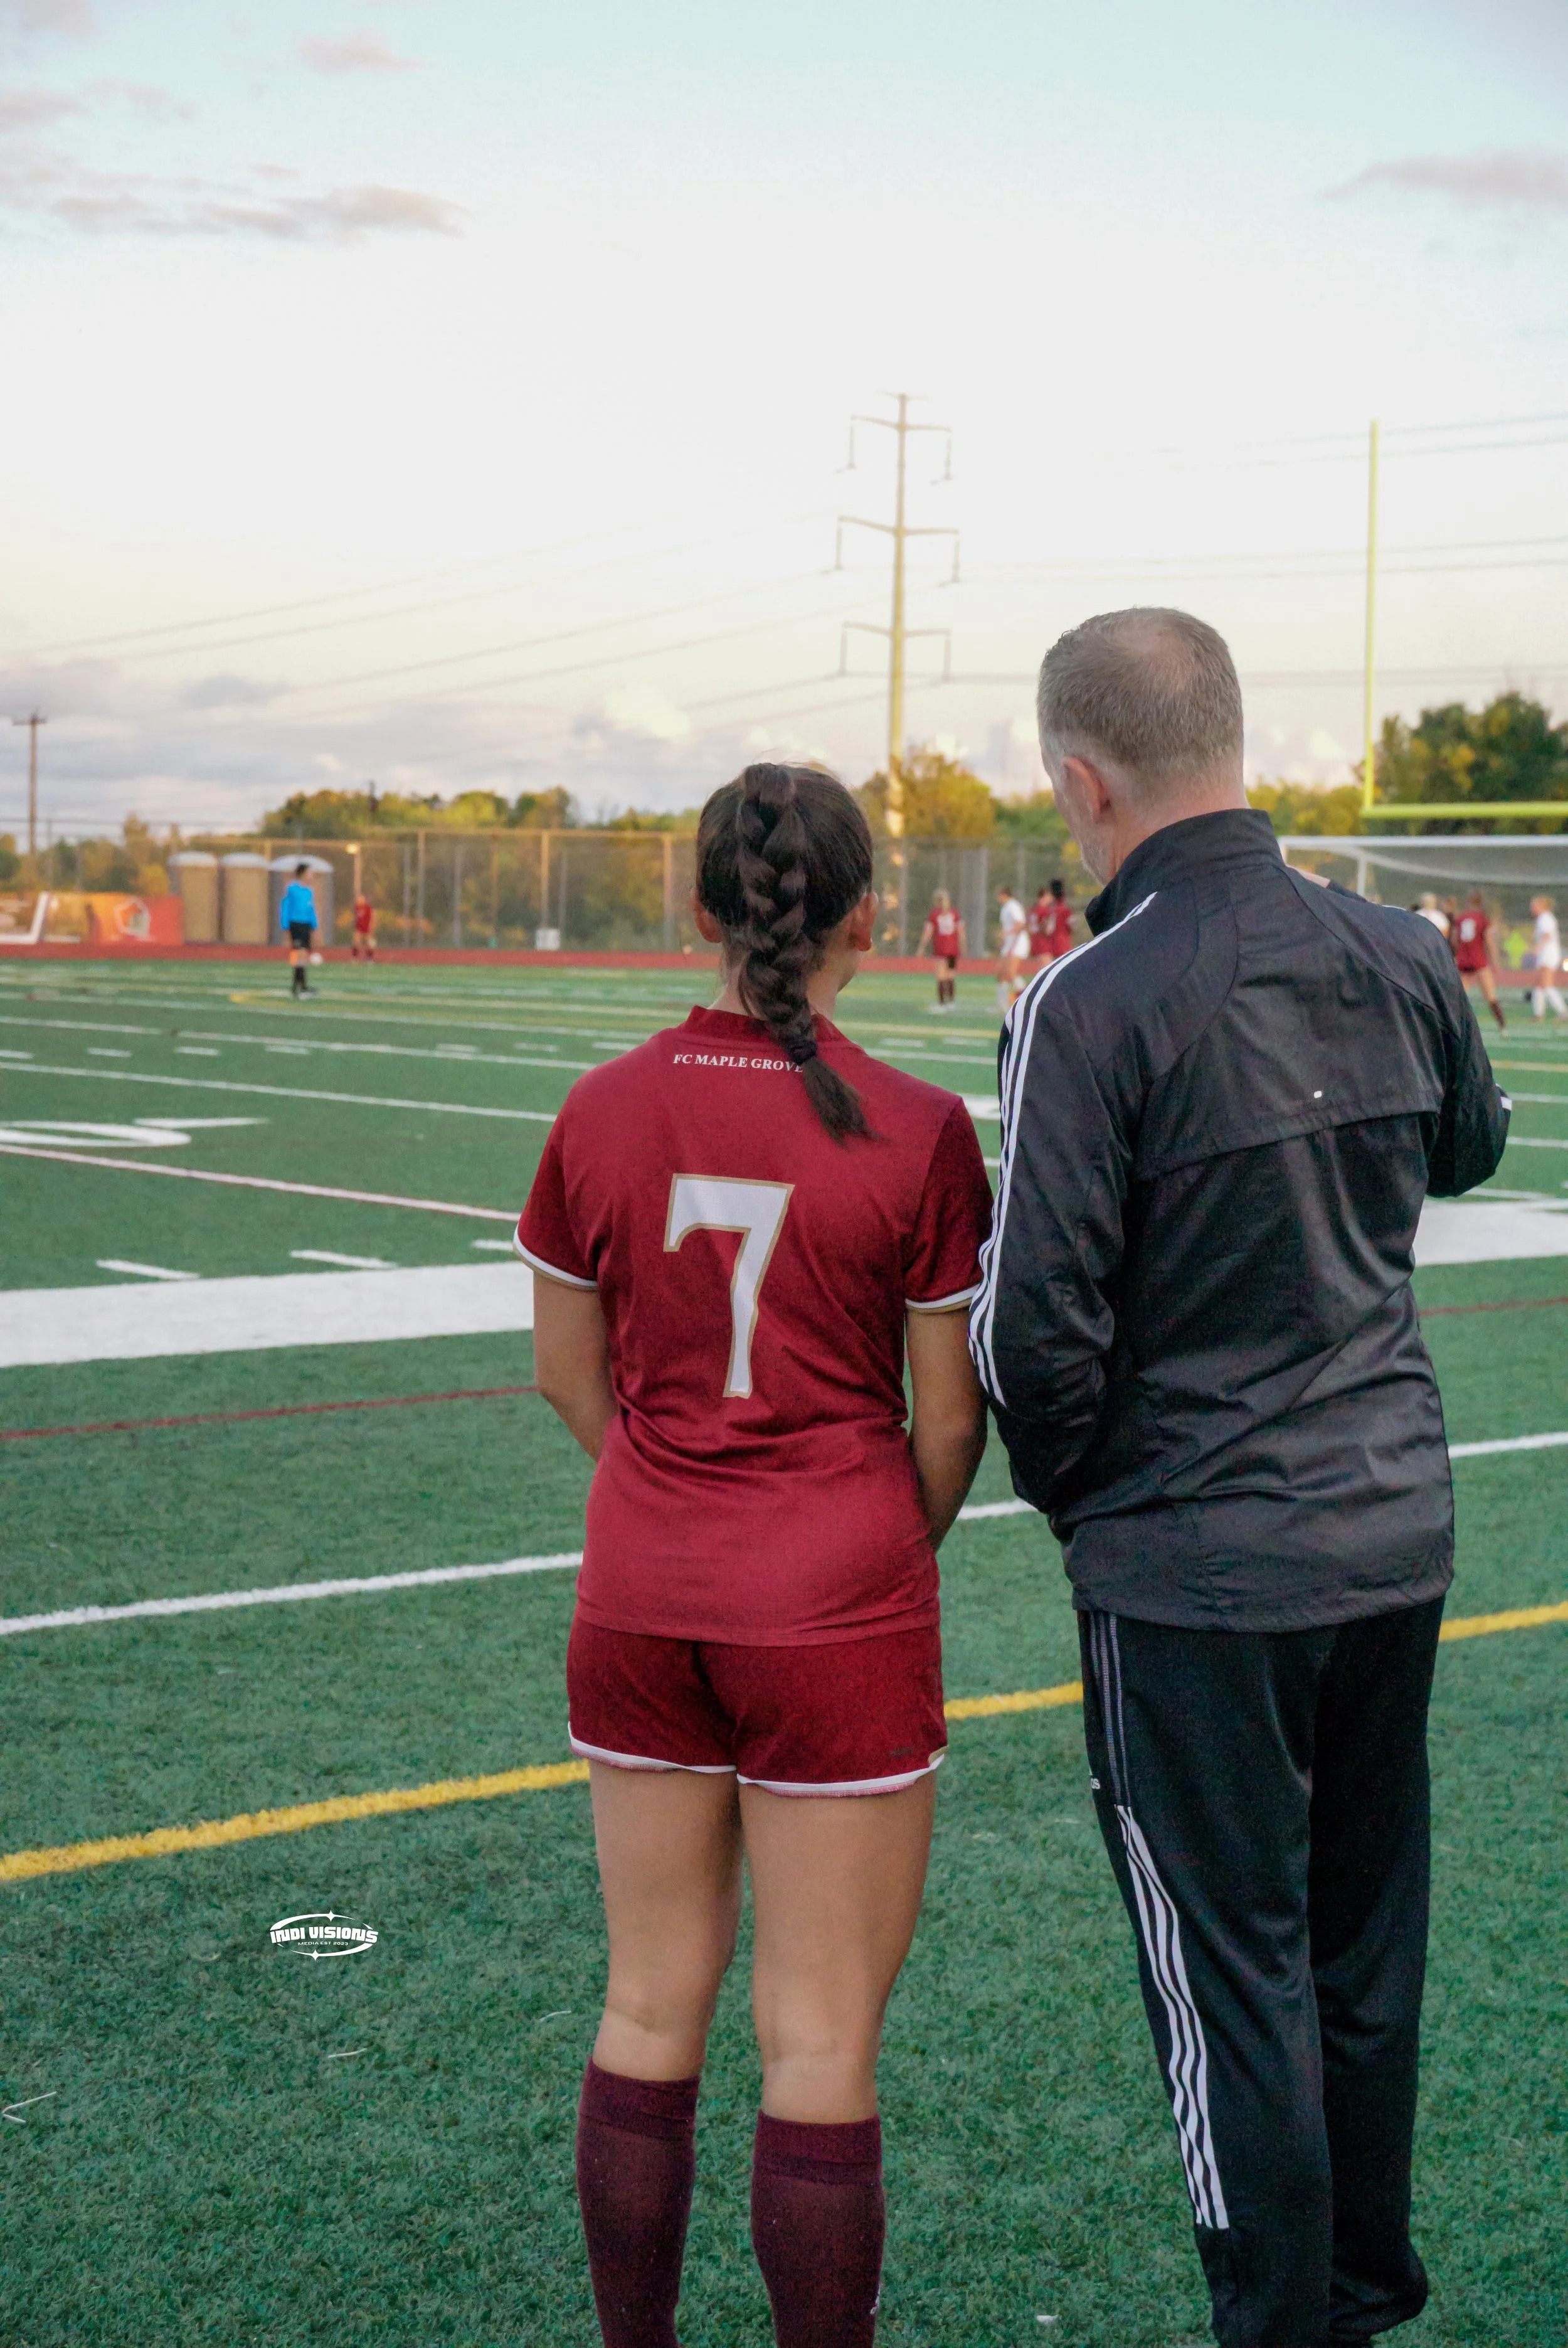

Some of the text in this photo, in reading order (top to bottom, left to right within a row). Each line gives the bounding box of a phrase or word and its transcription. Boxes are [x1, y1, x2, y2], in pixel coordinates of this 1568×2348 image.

[672, 1054, 693, 1064] FC
[695, 1054, 748, 1067] MAPLE
[663, 1173, 795, 1399] 7
